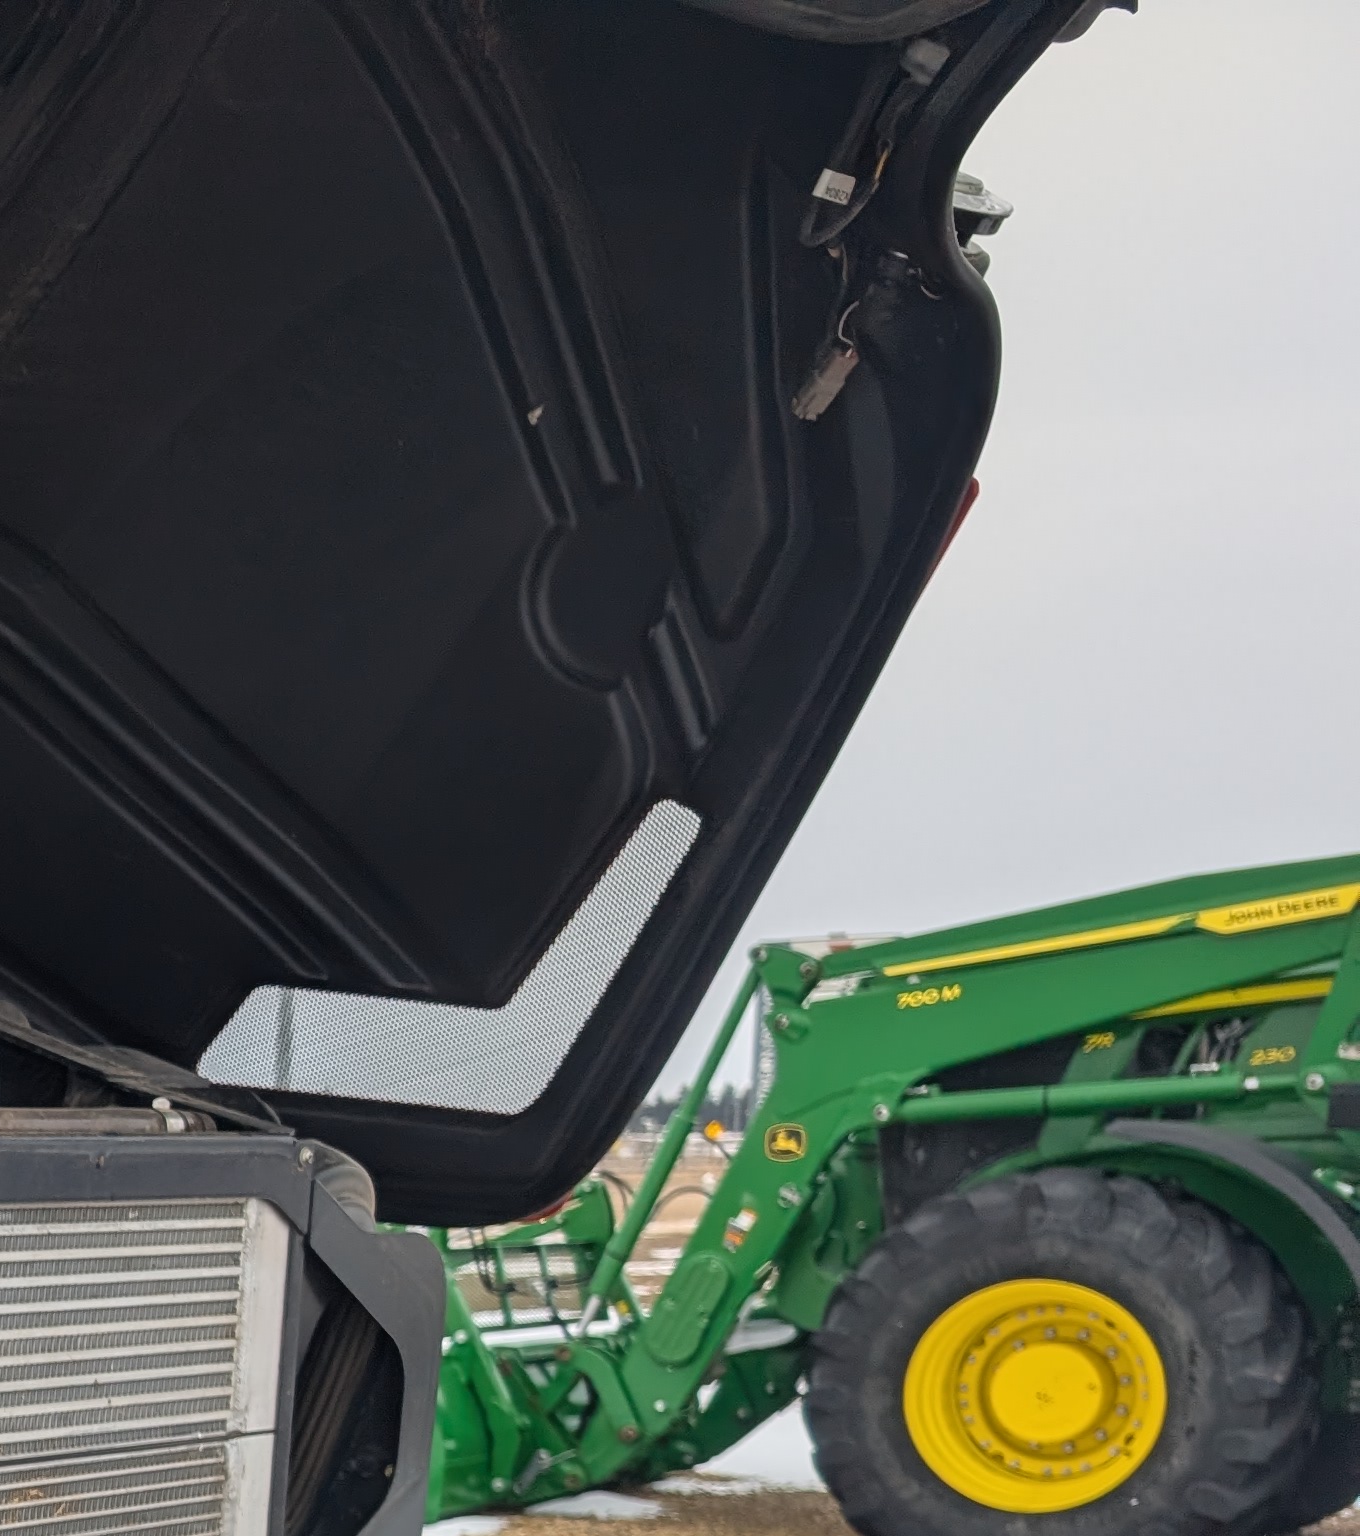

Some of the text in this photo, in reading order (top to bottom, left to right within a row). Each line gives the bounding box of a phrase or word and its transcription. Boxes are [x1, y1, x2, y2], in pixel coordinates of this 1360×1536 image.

[1224, 893, 1339, 926] JOHN DEERE
[1249, 1046, 1297, 1067] 230
